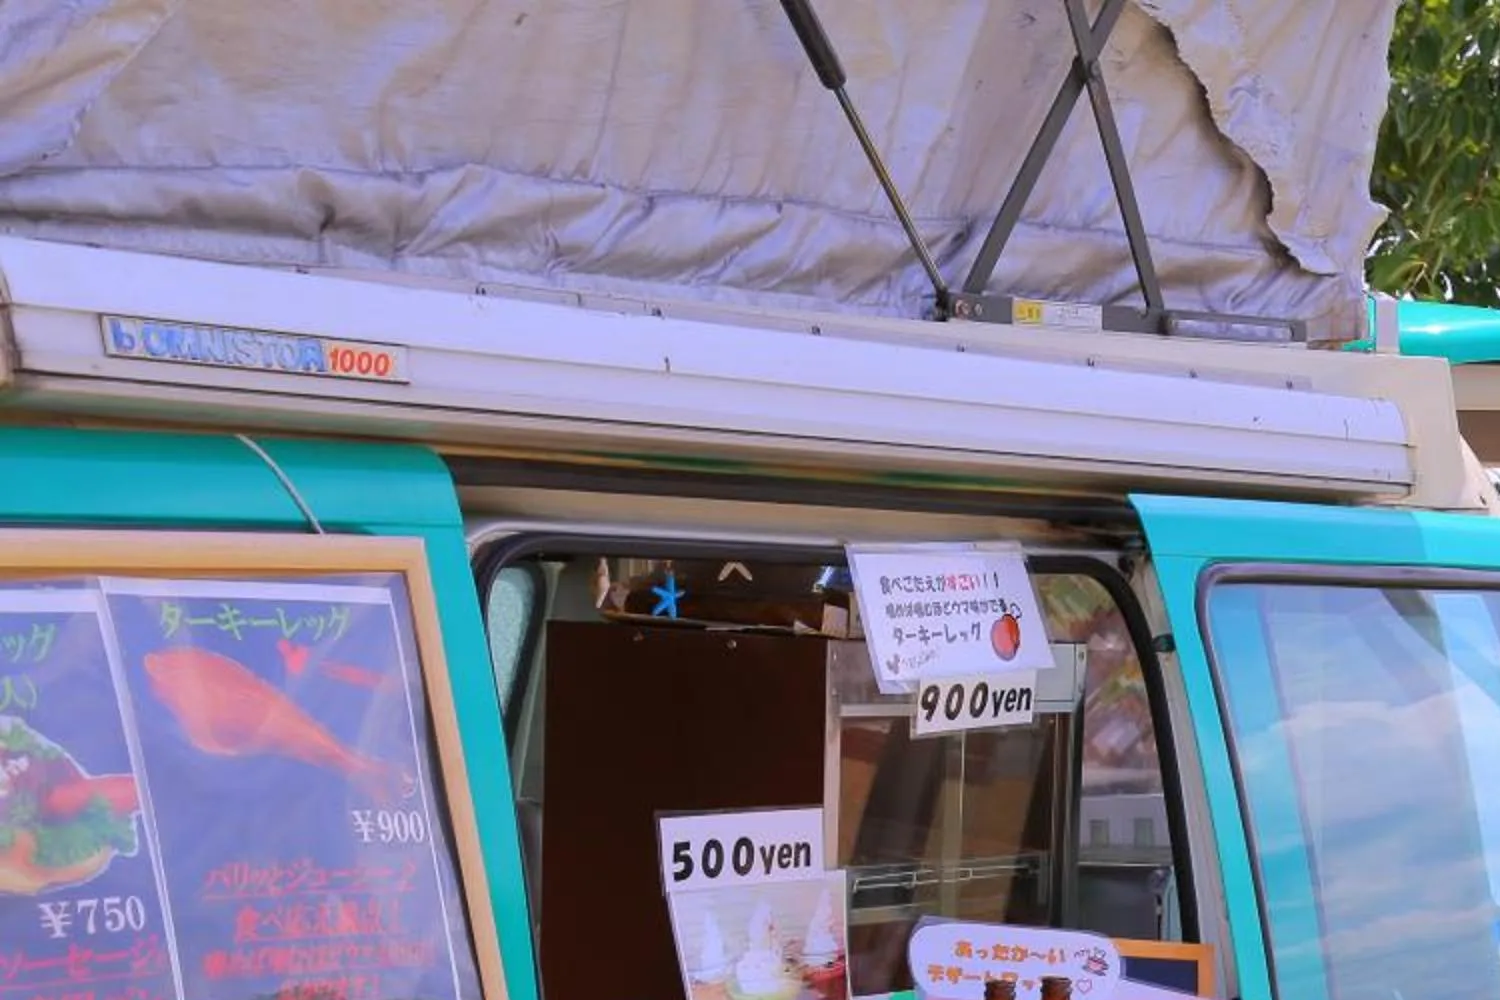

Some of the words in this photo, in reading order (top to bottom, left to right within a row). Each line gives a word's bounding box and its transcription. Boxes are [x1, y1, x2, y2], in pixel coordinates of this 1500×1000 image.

[330, 346, 393, 377] 1000
[159, 603, 351, 640] ターキーレッグ
[920, 681, 1033, 722] 900yen
[351, 810, 426, 844] ¥900
[672, 836, 812, 883] 500yen
[38, 895, 147, 939] ¥750
